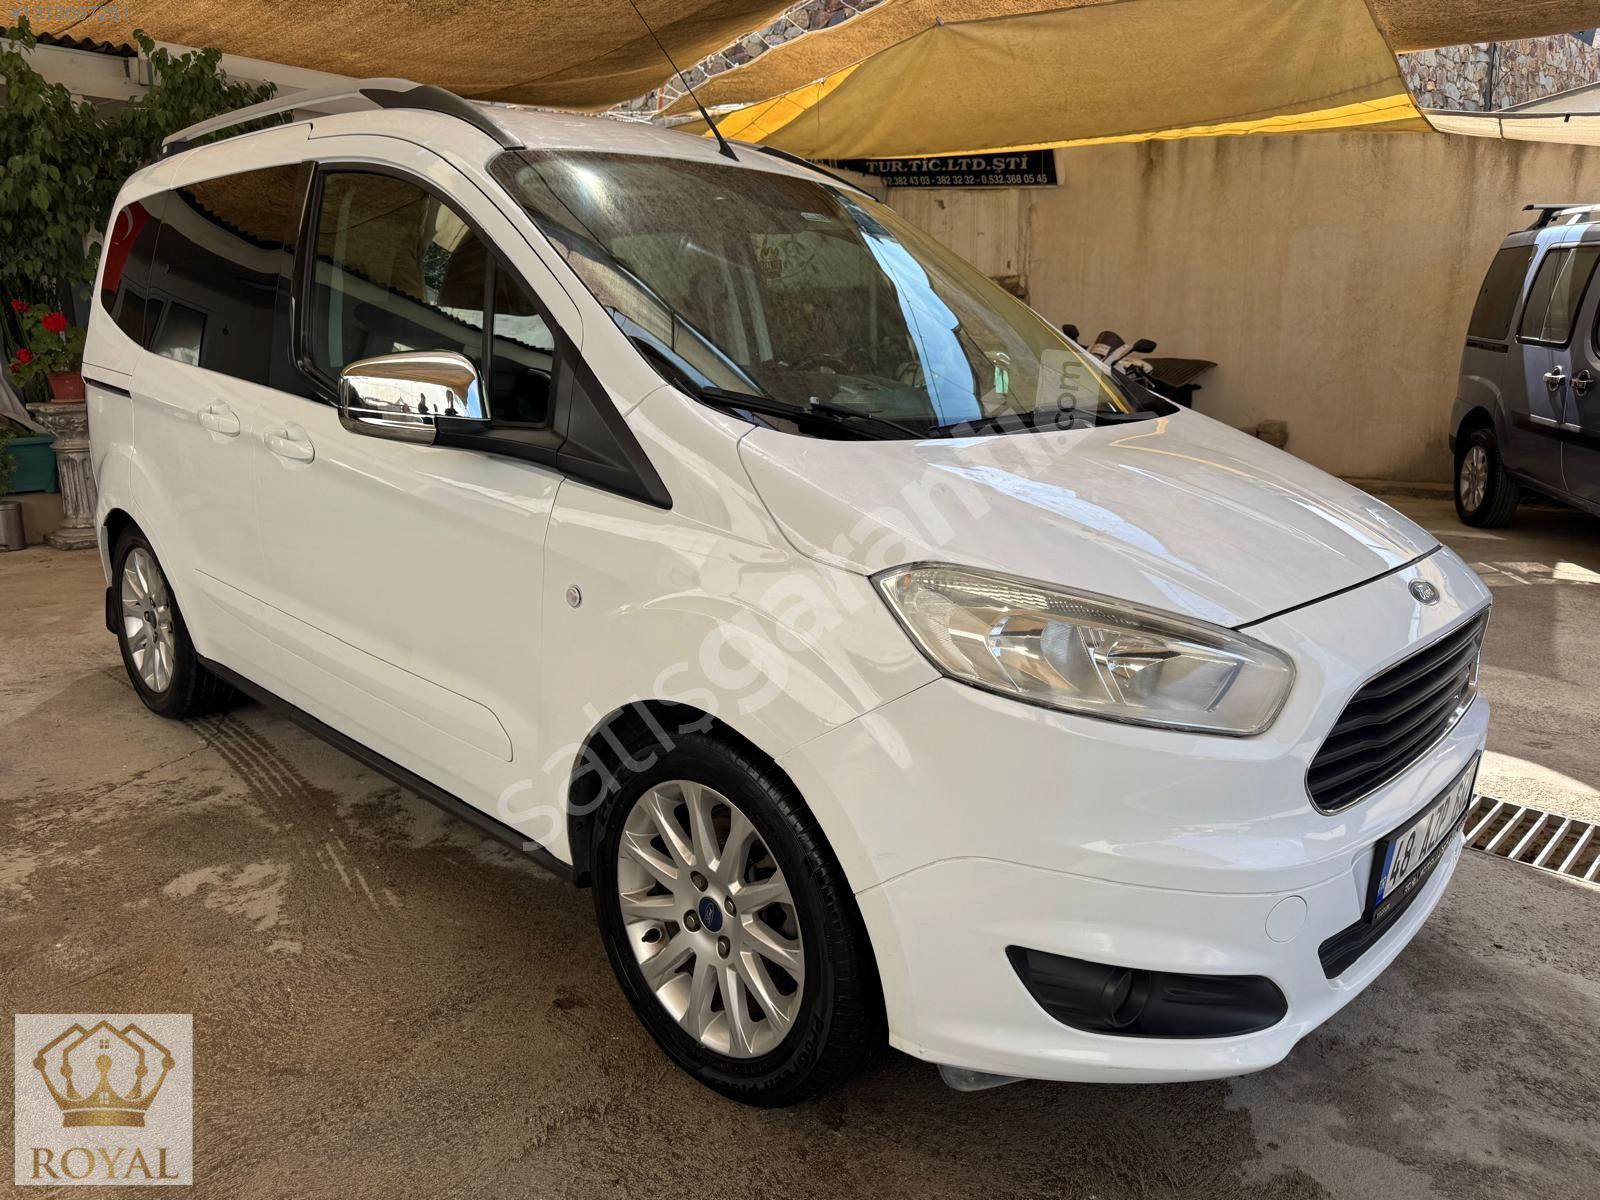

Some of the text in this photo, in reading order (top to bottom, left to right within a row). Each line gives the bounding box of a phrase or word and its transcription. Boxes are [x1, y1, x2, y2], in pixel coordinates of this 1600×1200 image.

[936, 175, 951, 185] 382
[952, 175, 963, 185] 32
[964, 175, 975, 184] 32
[1023, 174, 1035, 183] 05
[1036, 173, 1048, 183] 45
[1390, 830, 1416, 885] 48
